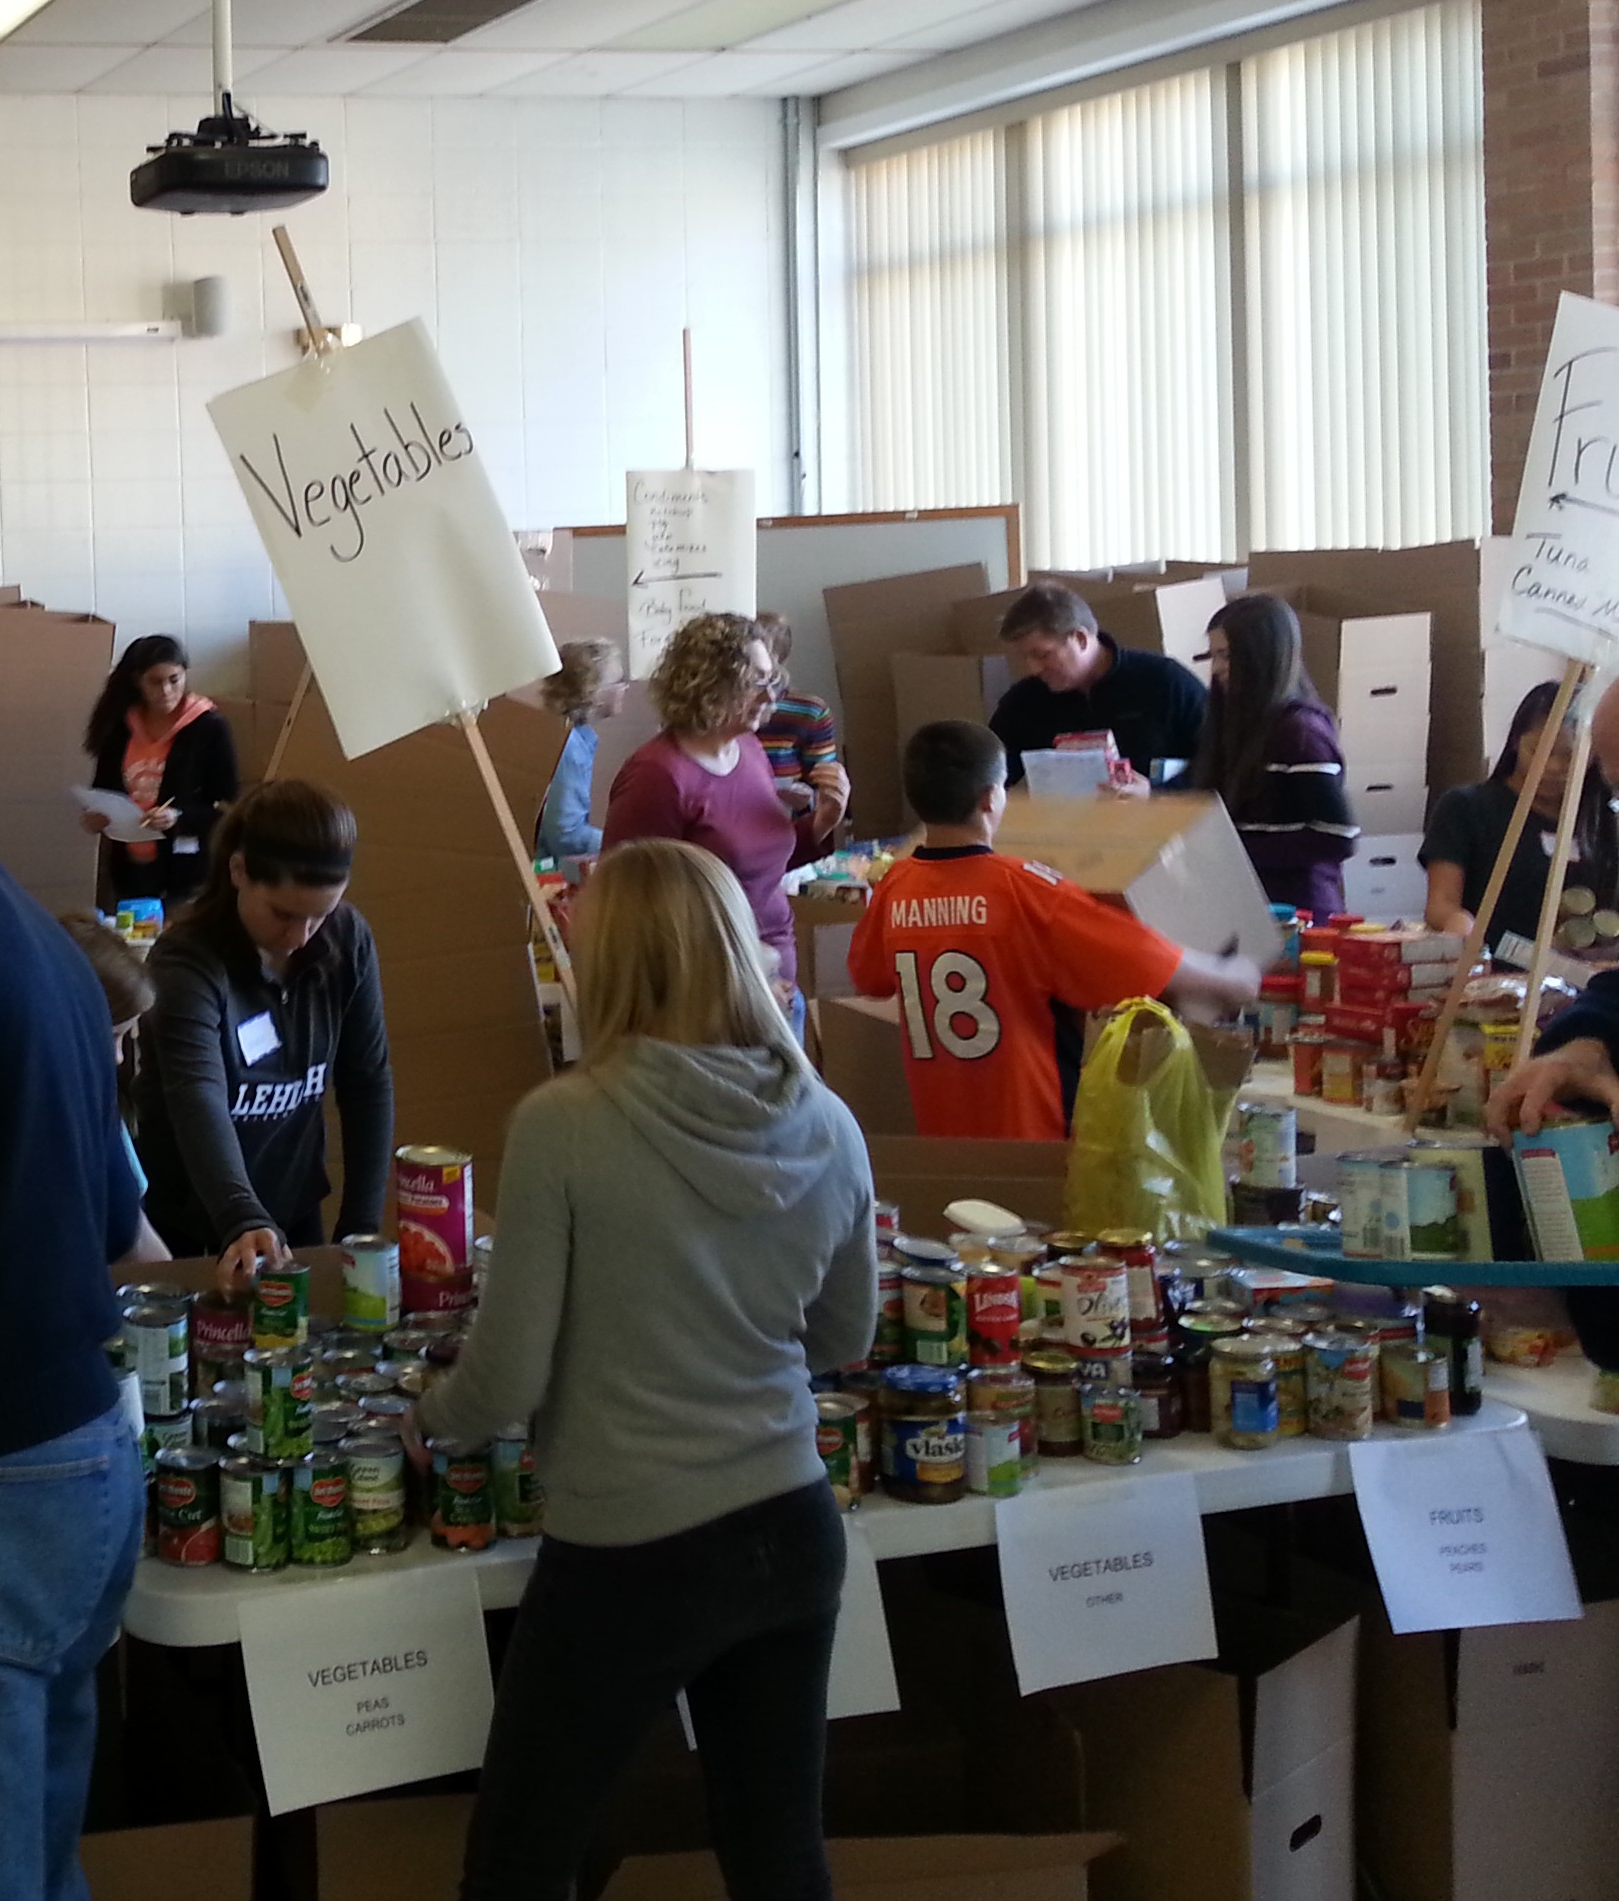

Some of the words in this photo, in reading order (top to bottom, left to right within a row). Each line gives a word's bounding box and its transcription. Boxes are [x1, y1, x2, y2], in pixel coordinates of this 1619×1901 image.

[239, 401, 476, 563] Vegetables
[1525, 531, 1590, 573] Tuna
[891, 895, 988, 929] MANNING
[894, 949, 1003, 1061] 18
[1429, 1507, 1485, 1526] FRUITS
[1048, 1551, 1155, 1583] VEGETABLES
[1085, 1592, 1124, 1609] OTHER
[307, 1649, 428, 1688] VEGETABLES
[356, 1697, 390, 1715] PEAS
[345, 1713, 406, 1738] CARROTS
